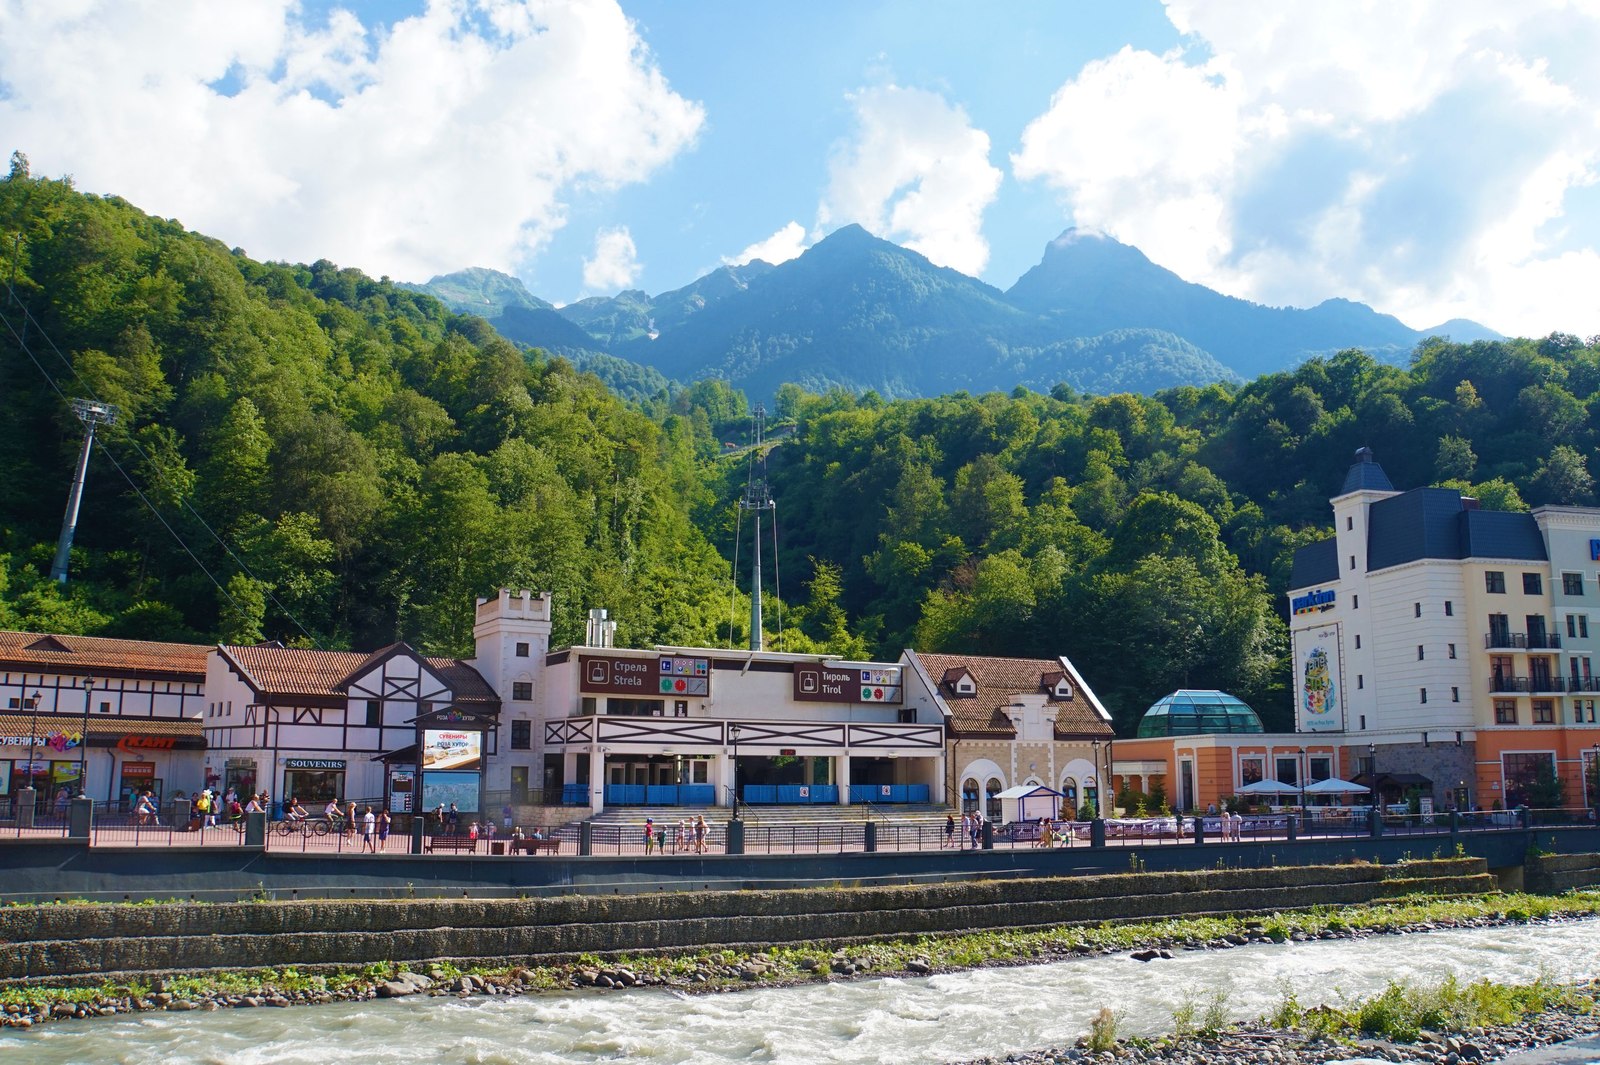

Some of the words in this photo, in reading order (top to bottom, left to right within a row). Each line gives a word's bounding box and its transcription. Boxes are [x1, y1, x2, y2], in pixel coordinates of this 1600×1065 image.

[614, 661, 648, 673] Стрела
[614, 675, 642, 686] Strela
[822, 671, 851, 682] Тироль
[822, 684, 842, 694] Tirol
[127, 735, 177, 749] КАНТ
[452, 740, 469, 748] ХУТОР
[291, 760, 343, 768] SOUVENIRS
